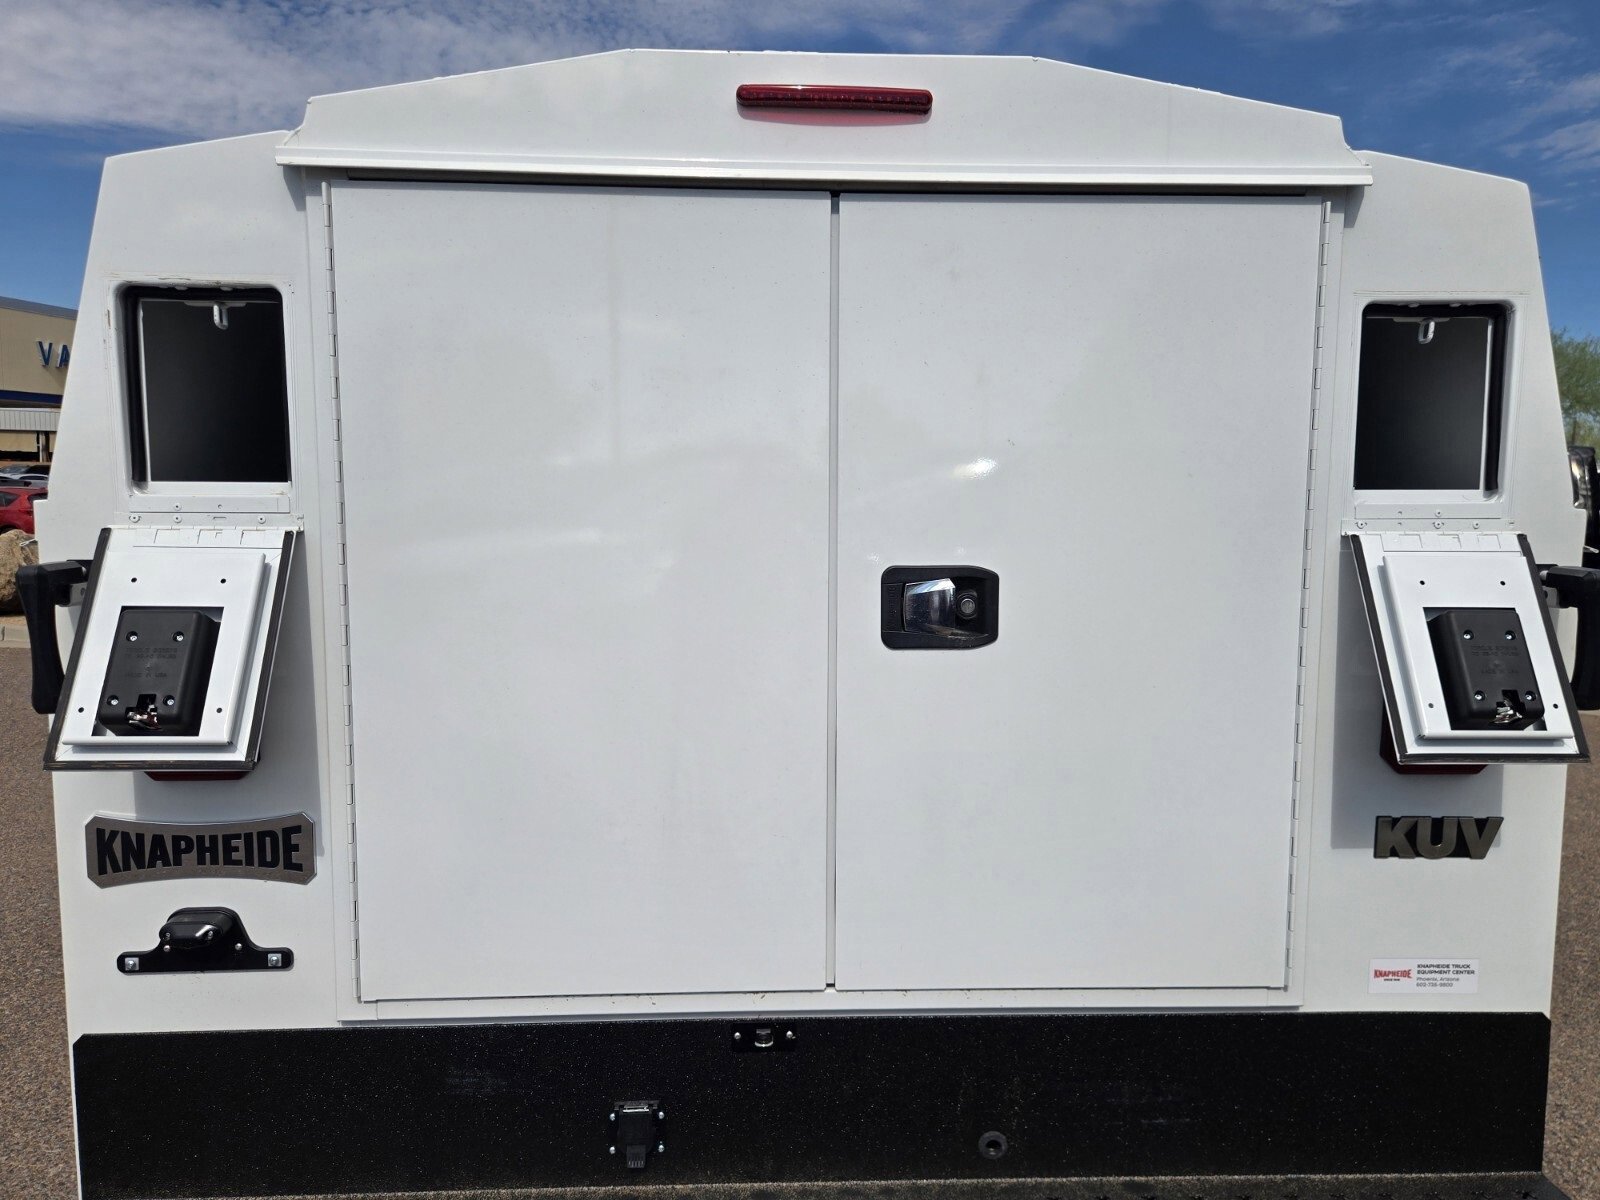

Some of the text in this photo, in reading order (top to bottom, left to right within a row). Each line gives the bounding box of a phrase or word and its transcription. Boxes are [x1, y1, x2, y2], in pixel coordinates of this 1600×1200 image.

[96, 825, 304, 876] KNAPHEIDE
[1374, 816, 1504, 859] KUV
[1374, 969, 1412, 979] KNAPHEIDE
